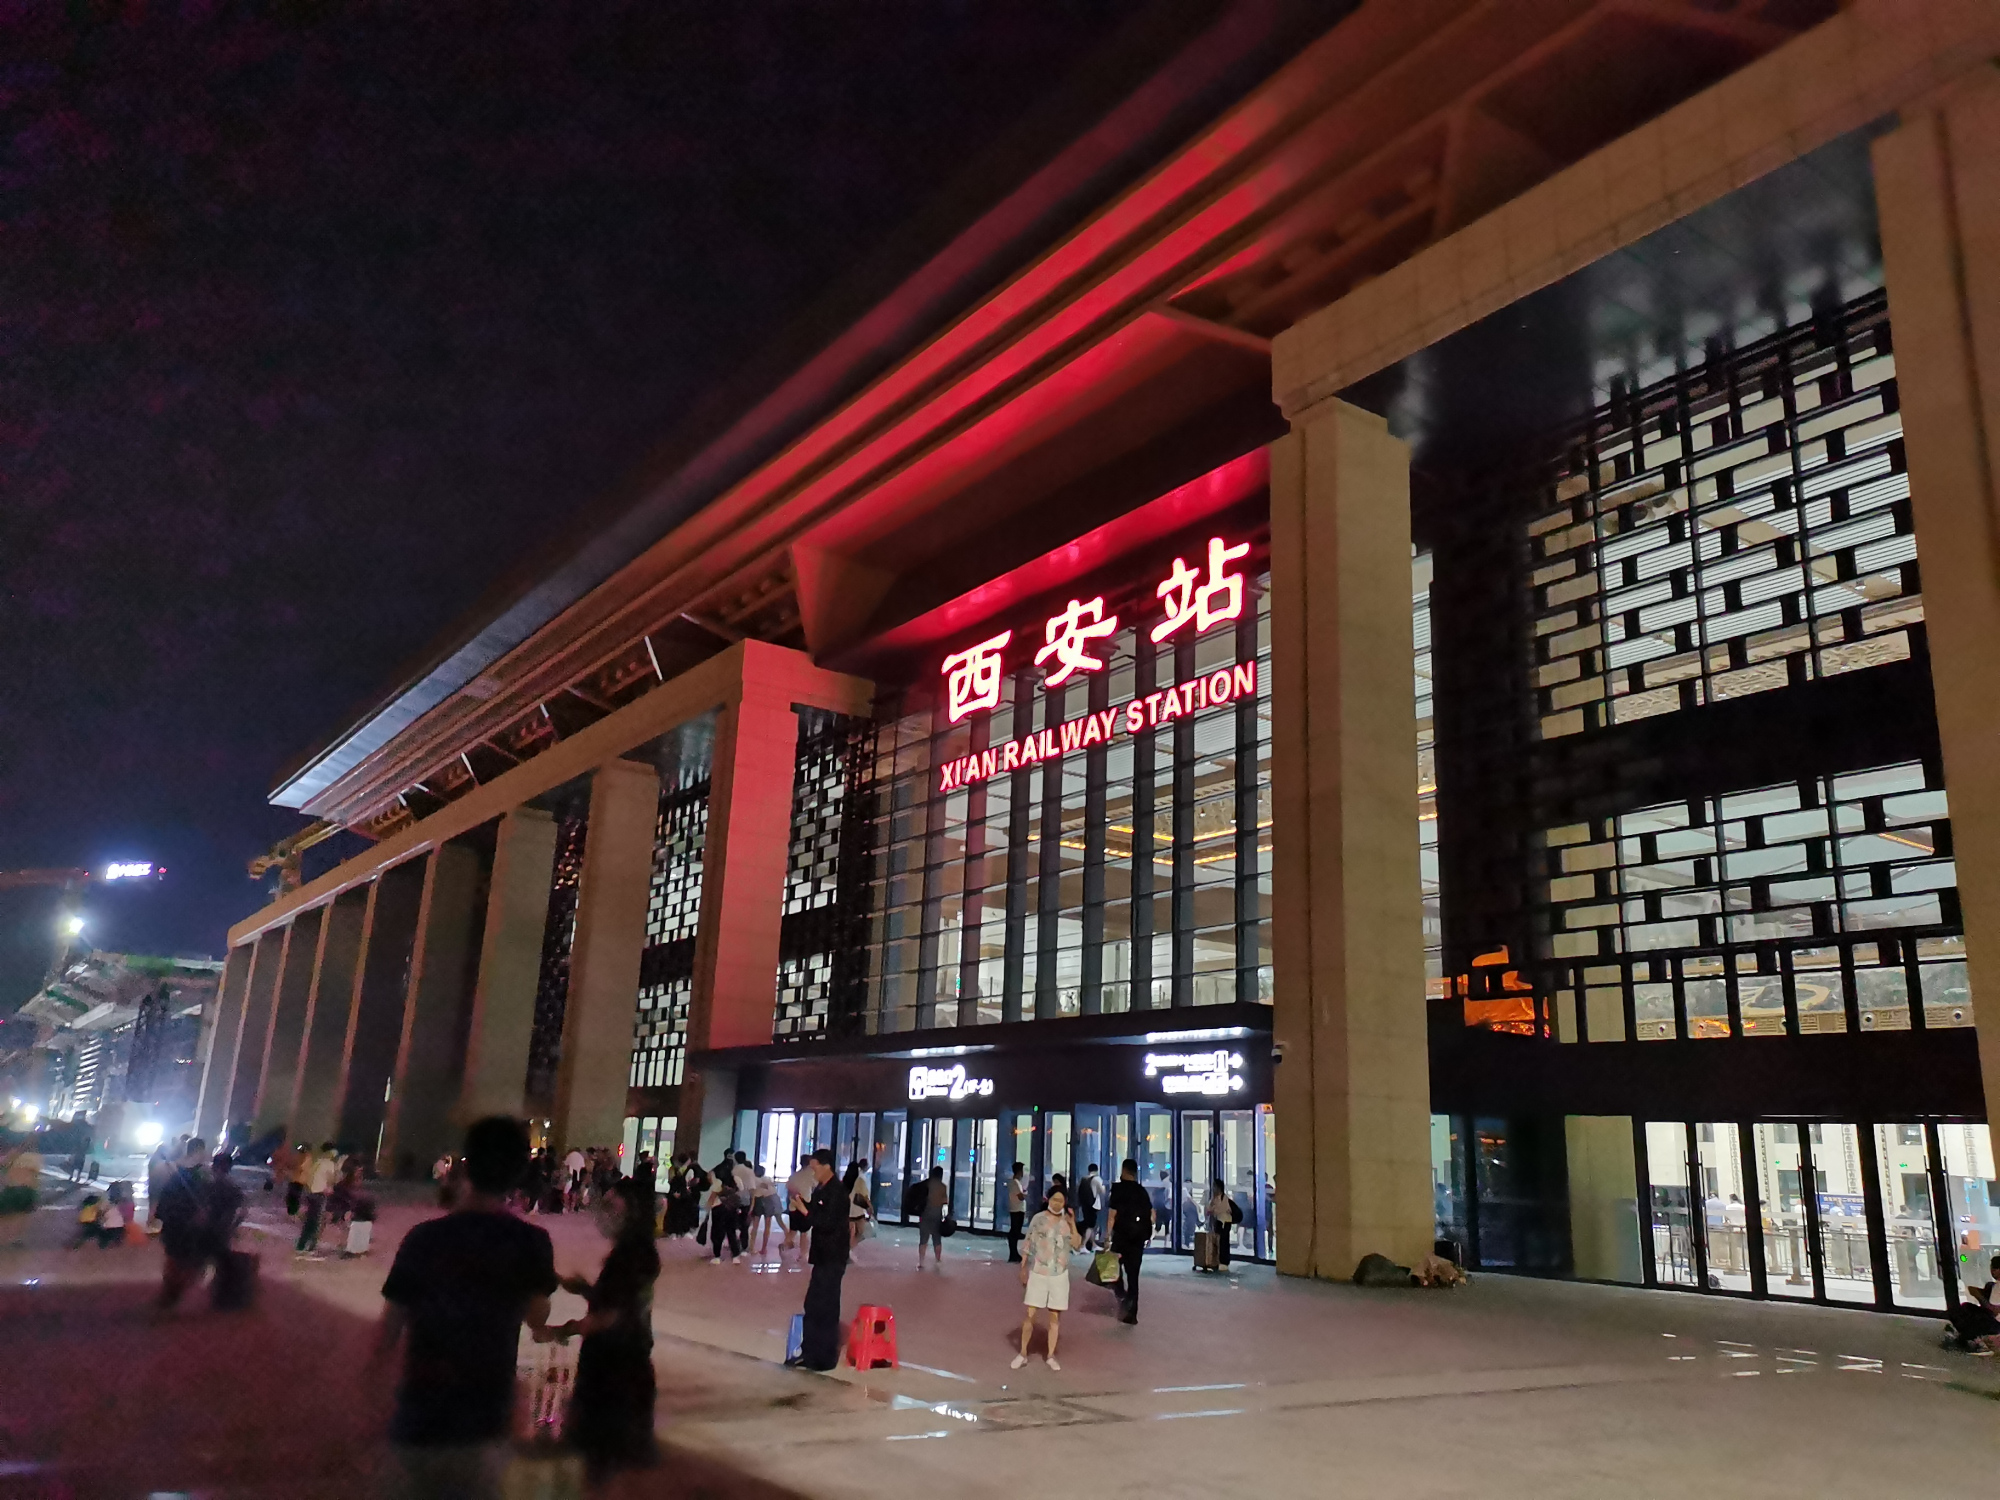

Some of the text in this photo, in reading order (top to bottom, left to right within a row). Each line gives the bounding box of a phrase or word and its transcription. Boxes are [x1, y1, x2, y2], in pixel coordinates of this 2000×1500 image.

[941, 537, 1250, 723] 西安站
[940, 661, 1256, 792] XI'AN RAILWAY STATION
